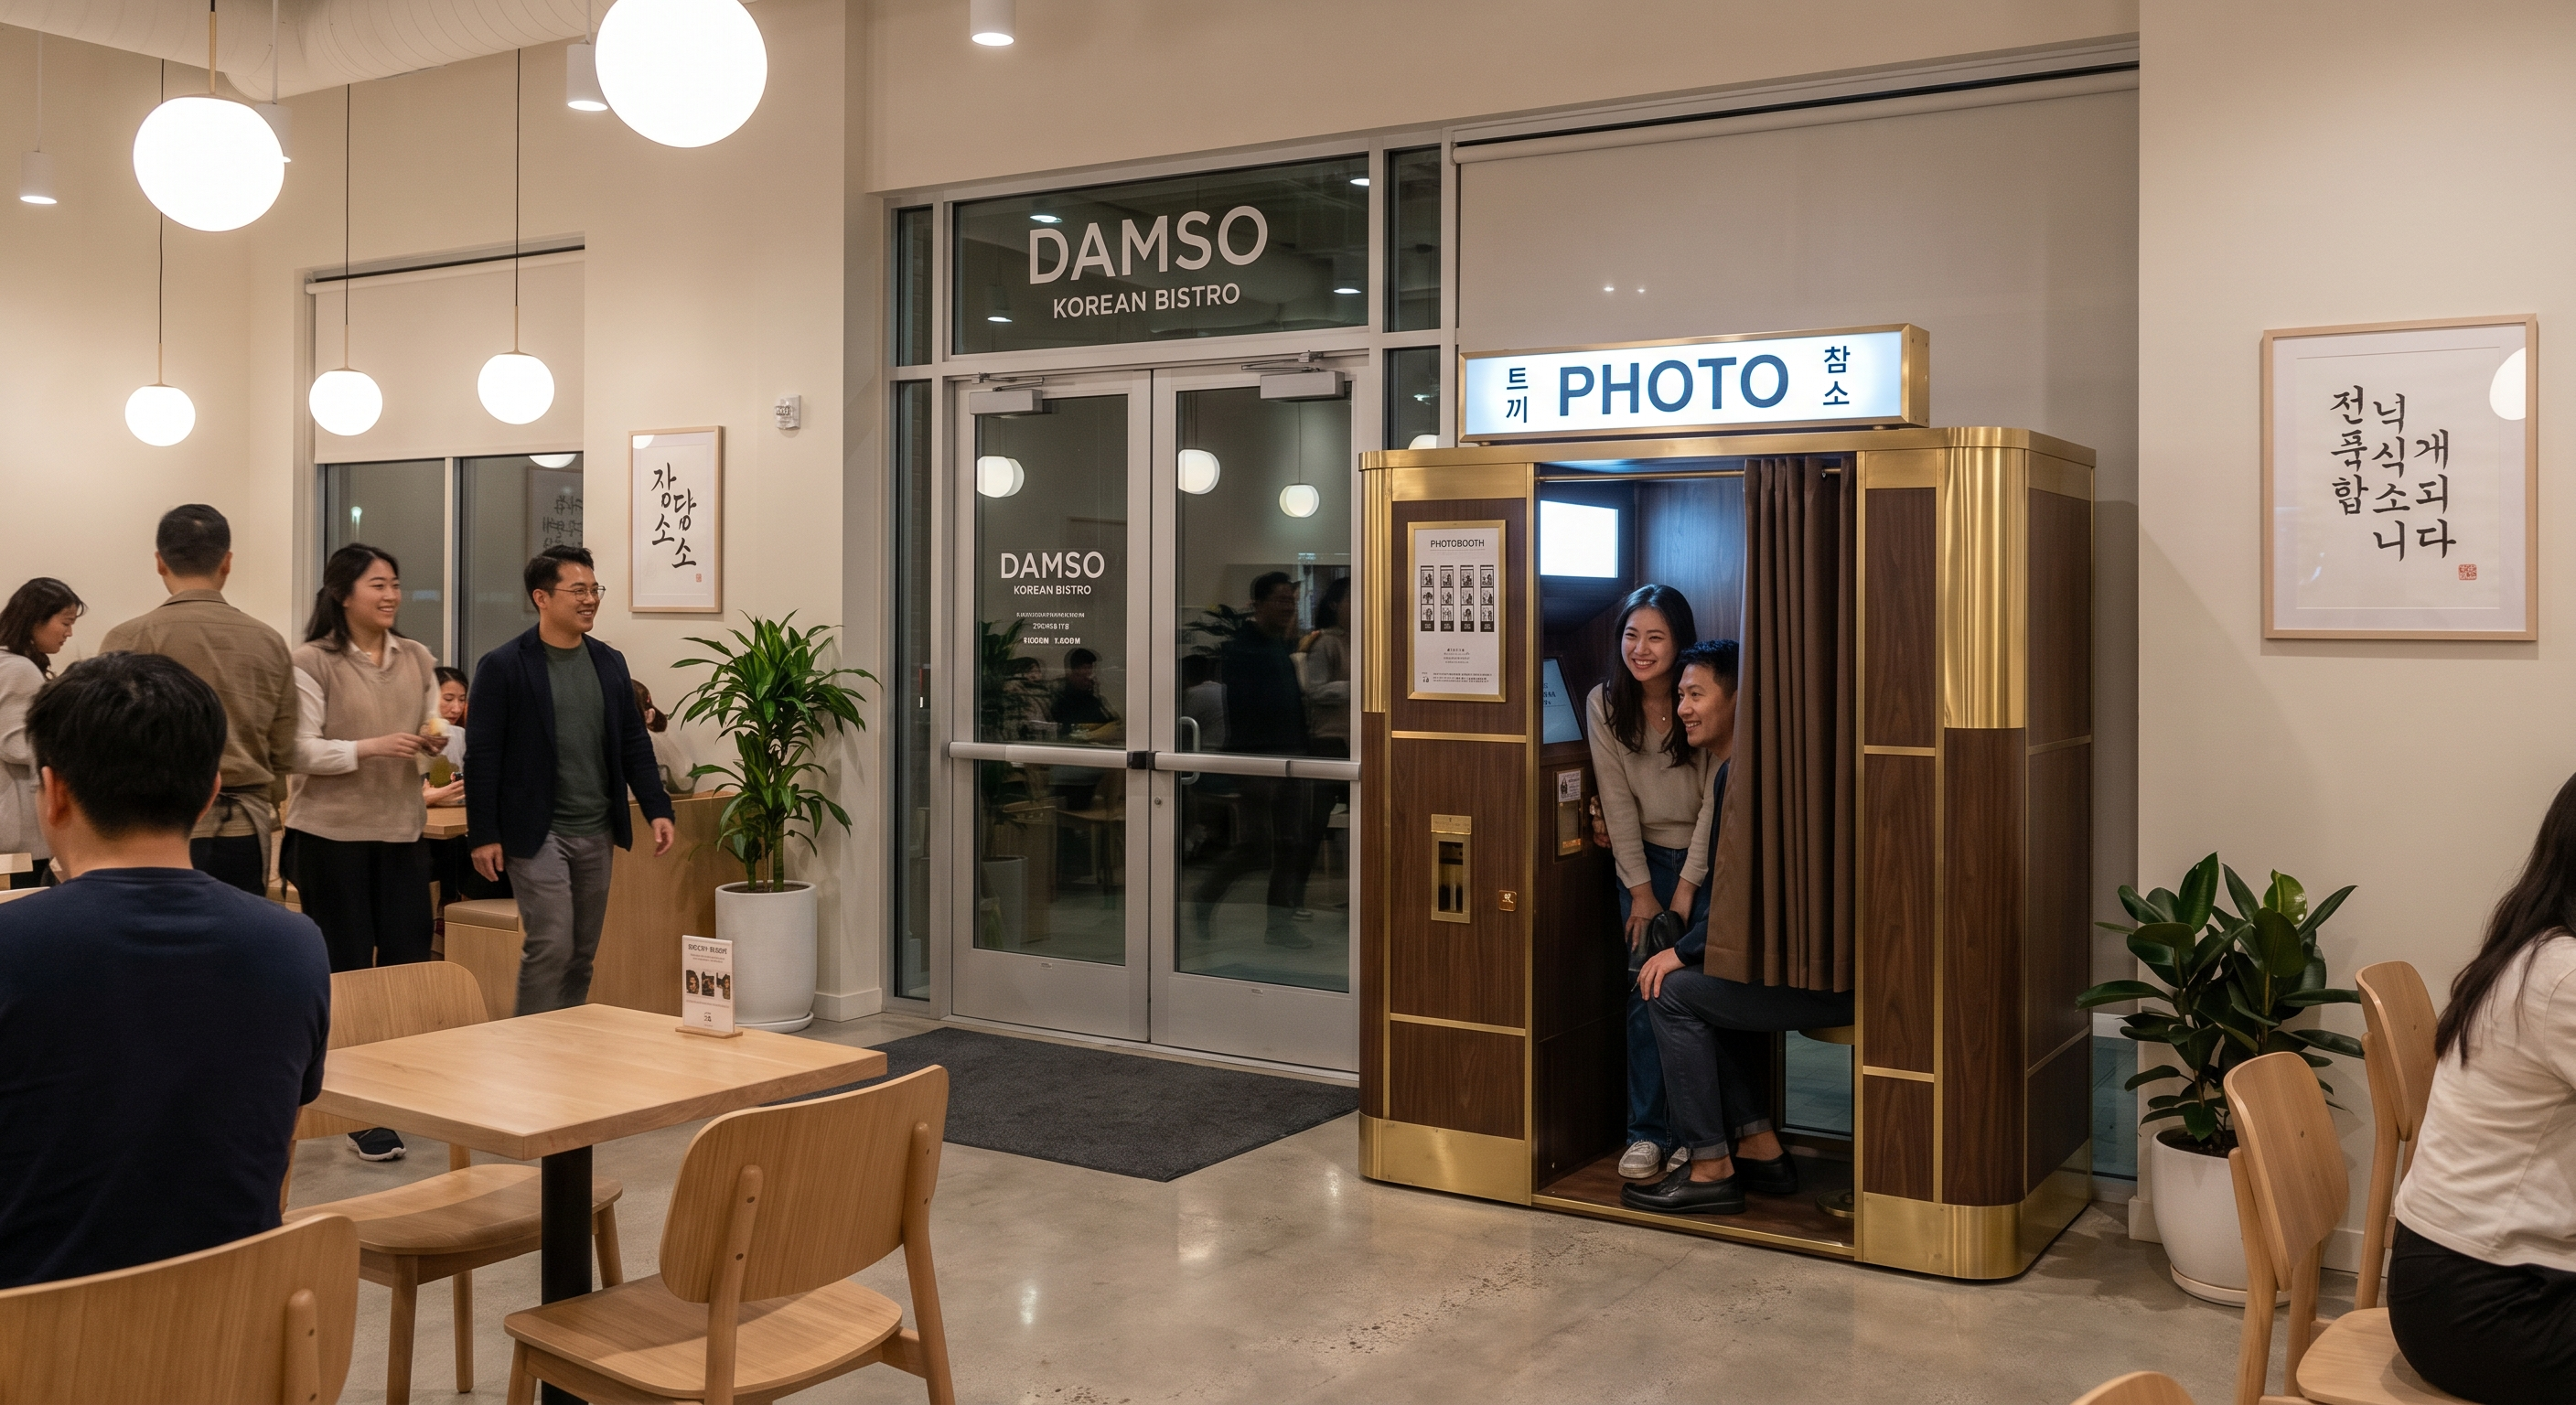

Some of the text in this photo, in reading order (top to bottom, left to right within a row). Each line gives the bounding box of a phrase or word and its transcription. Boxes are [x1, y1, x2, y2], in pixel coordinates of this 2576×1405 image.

[1028, 205, 1269, 285] DAMSO
[1053, 283, 1240, 319] KOREAN BISTRO
[1559, 354, 1789, 417] PHOTO
[1822, 345, 1851, 406] 참소
[1430, 539, 1485, 548] PHOTOBOOTH
[1001, 551, 1105, 579] DAMSO
[1014, 585, 1092, 595] KOREAN BISTRO
